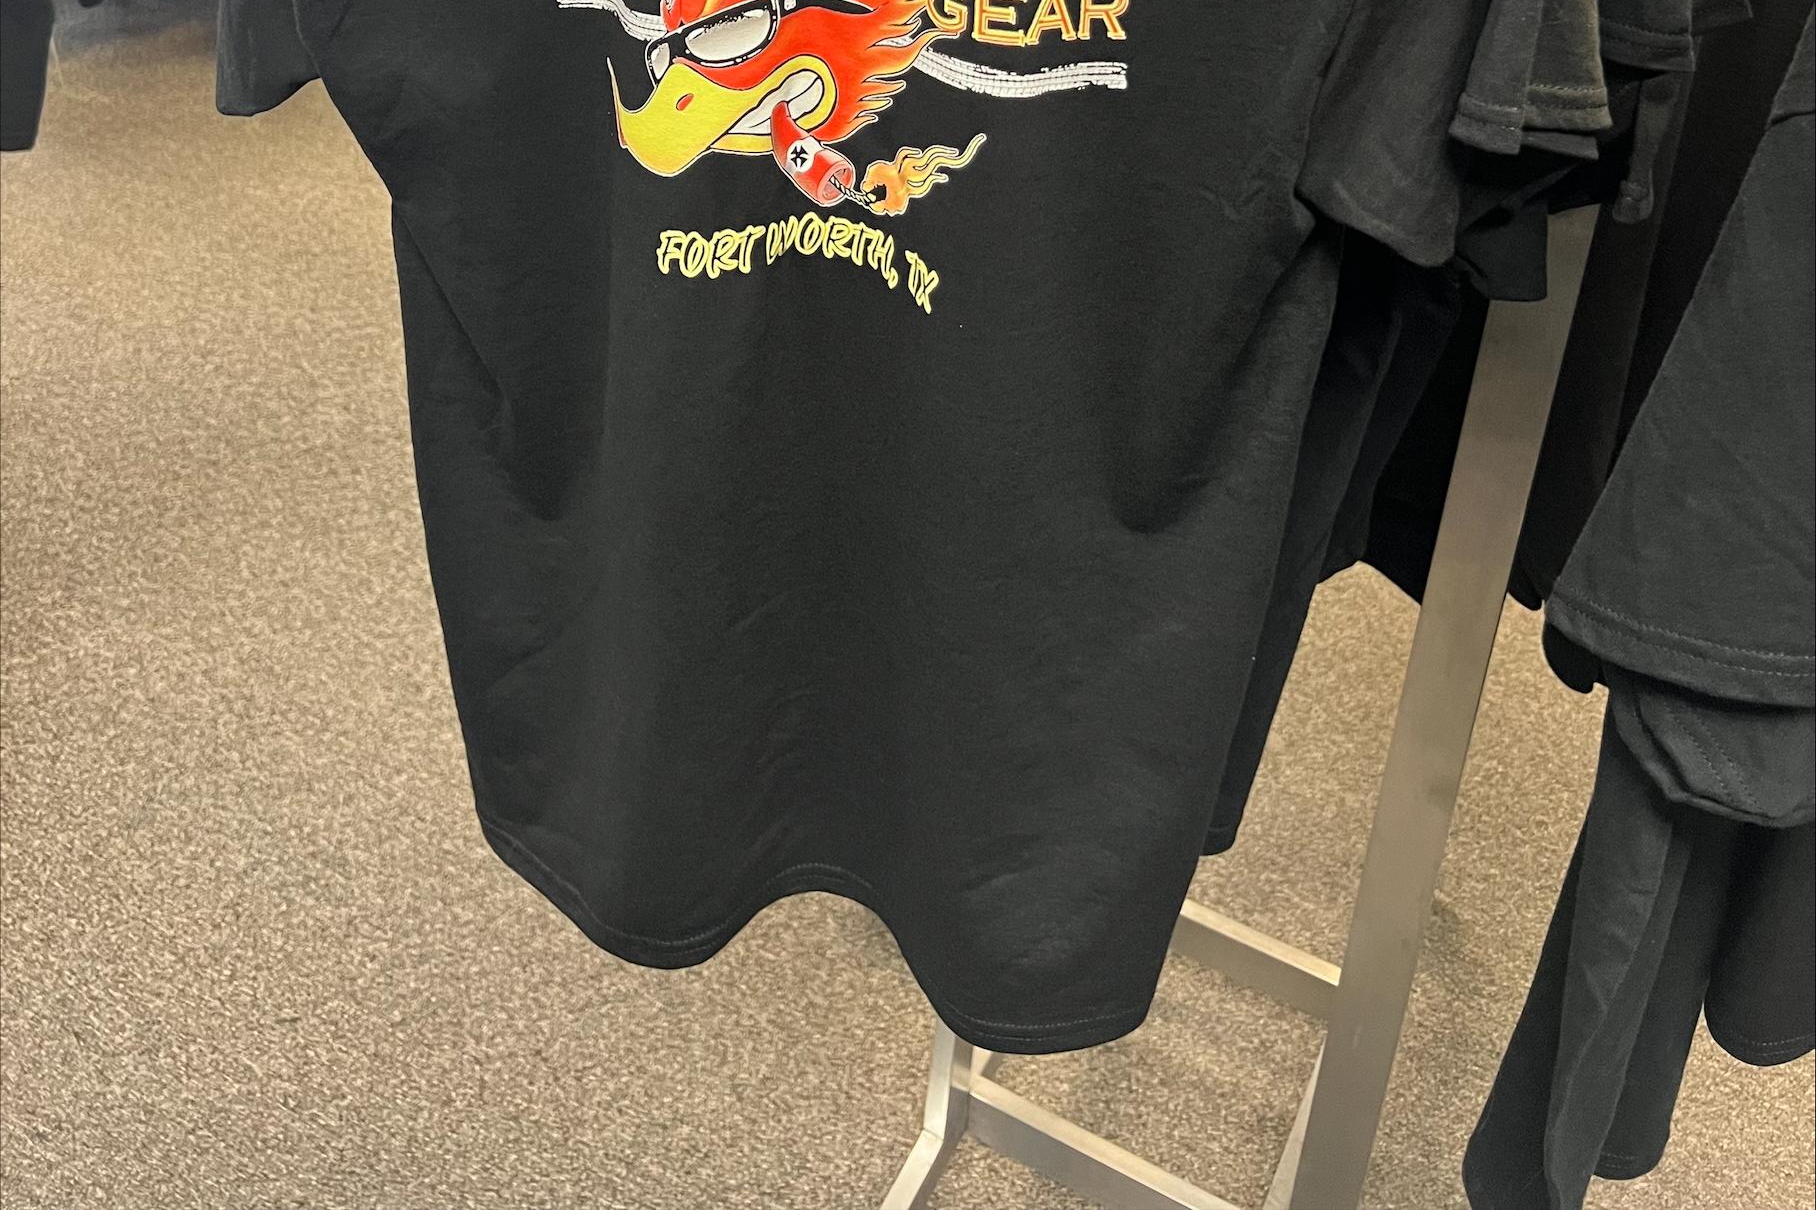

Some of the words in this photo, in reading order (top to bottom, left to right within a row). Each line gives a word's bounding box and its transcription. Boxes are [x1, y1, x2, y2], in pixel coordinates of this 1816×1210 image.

[656, 228, 766, 280] FORT
[765, 211, 899, 290] WORTH,
[904, 249, 940, 315] TX
